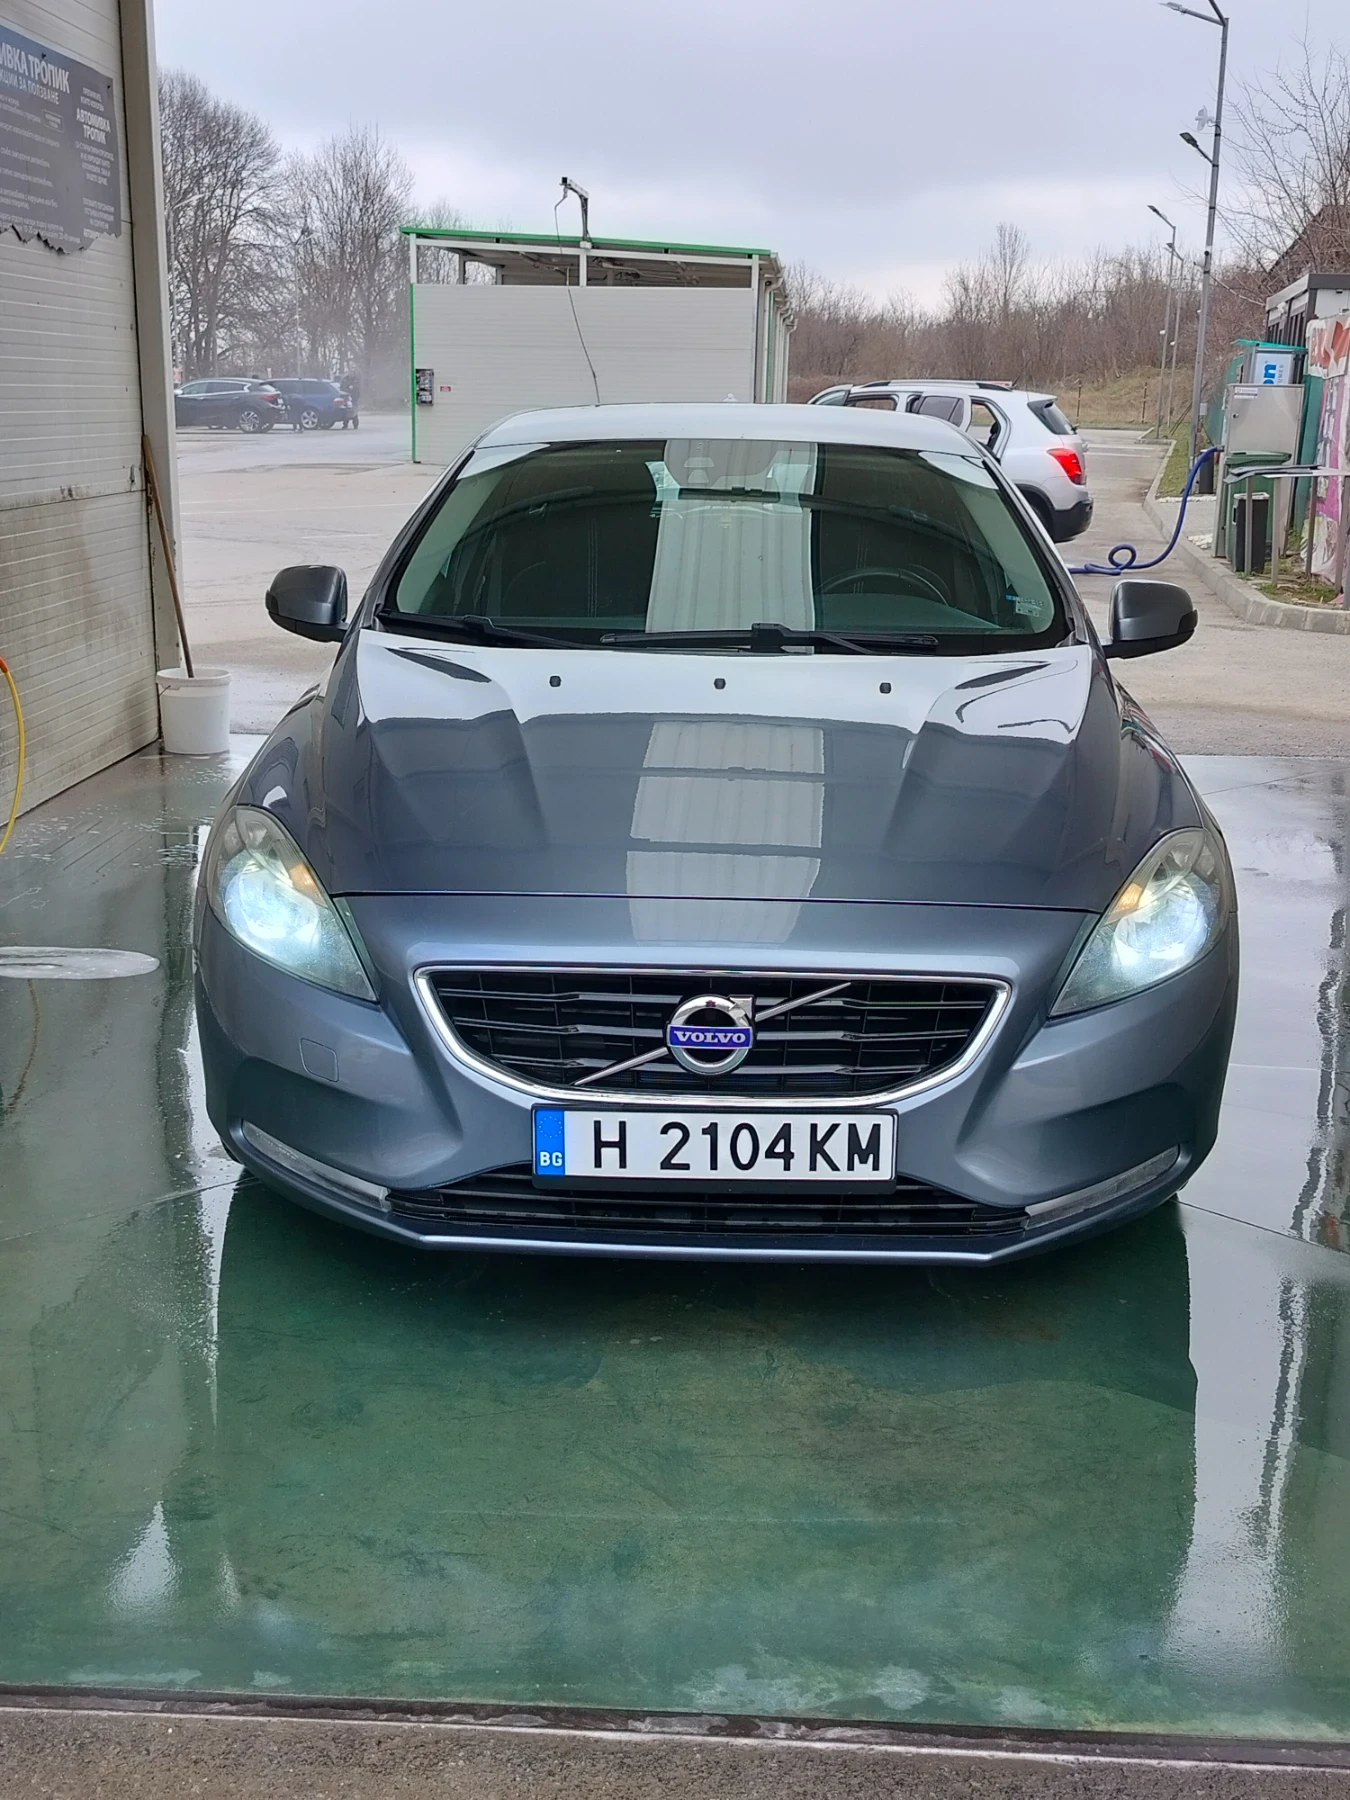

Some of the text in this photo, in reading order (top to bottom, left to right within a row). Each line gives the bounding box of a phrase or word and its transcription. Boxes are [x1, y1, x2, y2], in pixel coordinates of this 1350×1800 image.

[28, 54, 70, 94] ТРОПИК
[83, 124, 107, 145] ТРОПИК
[673, 1030, 746, 1043] VOLVO
[593, 1120, 627, 1169] H
[540, 1151, 562, 1167] BG
